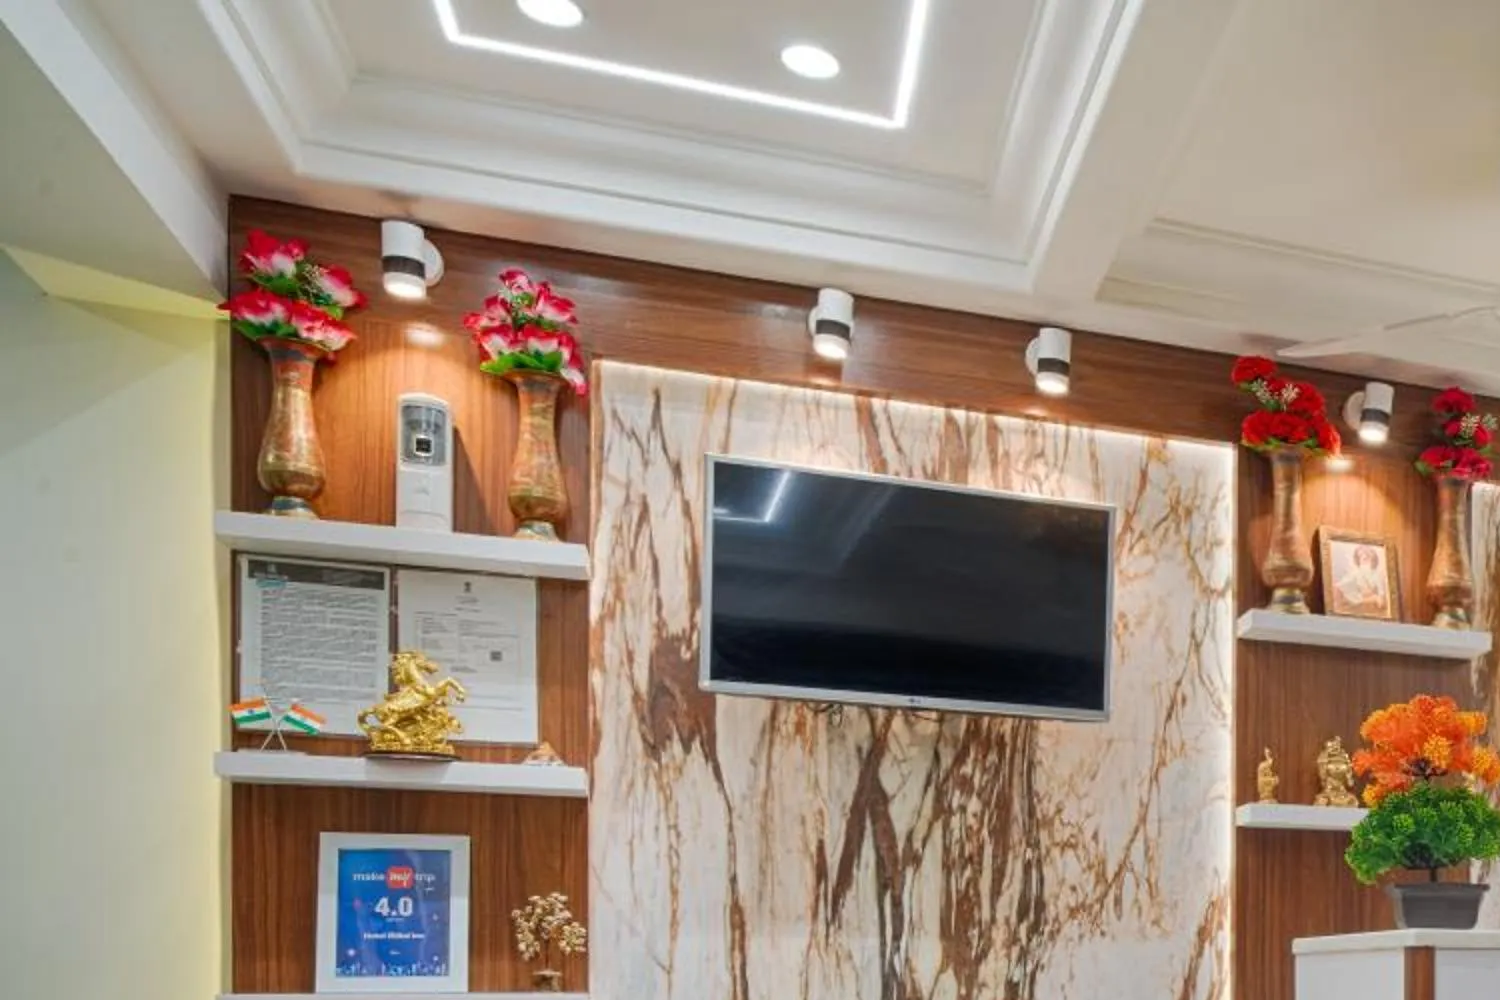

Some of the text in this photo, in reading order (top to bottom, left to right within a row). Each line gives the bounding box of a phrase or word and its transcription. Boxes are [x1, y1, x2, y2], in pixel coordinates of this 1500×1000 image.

[352, 872, 385, 881] make
[389, 872, 411, 888] my
[375, 896, 413, 916] 4.0
